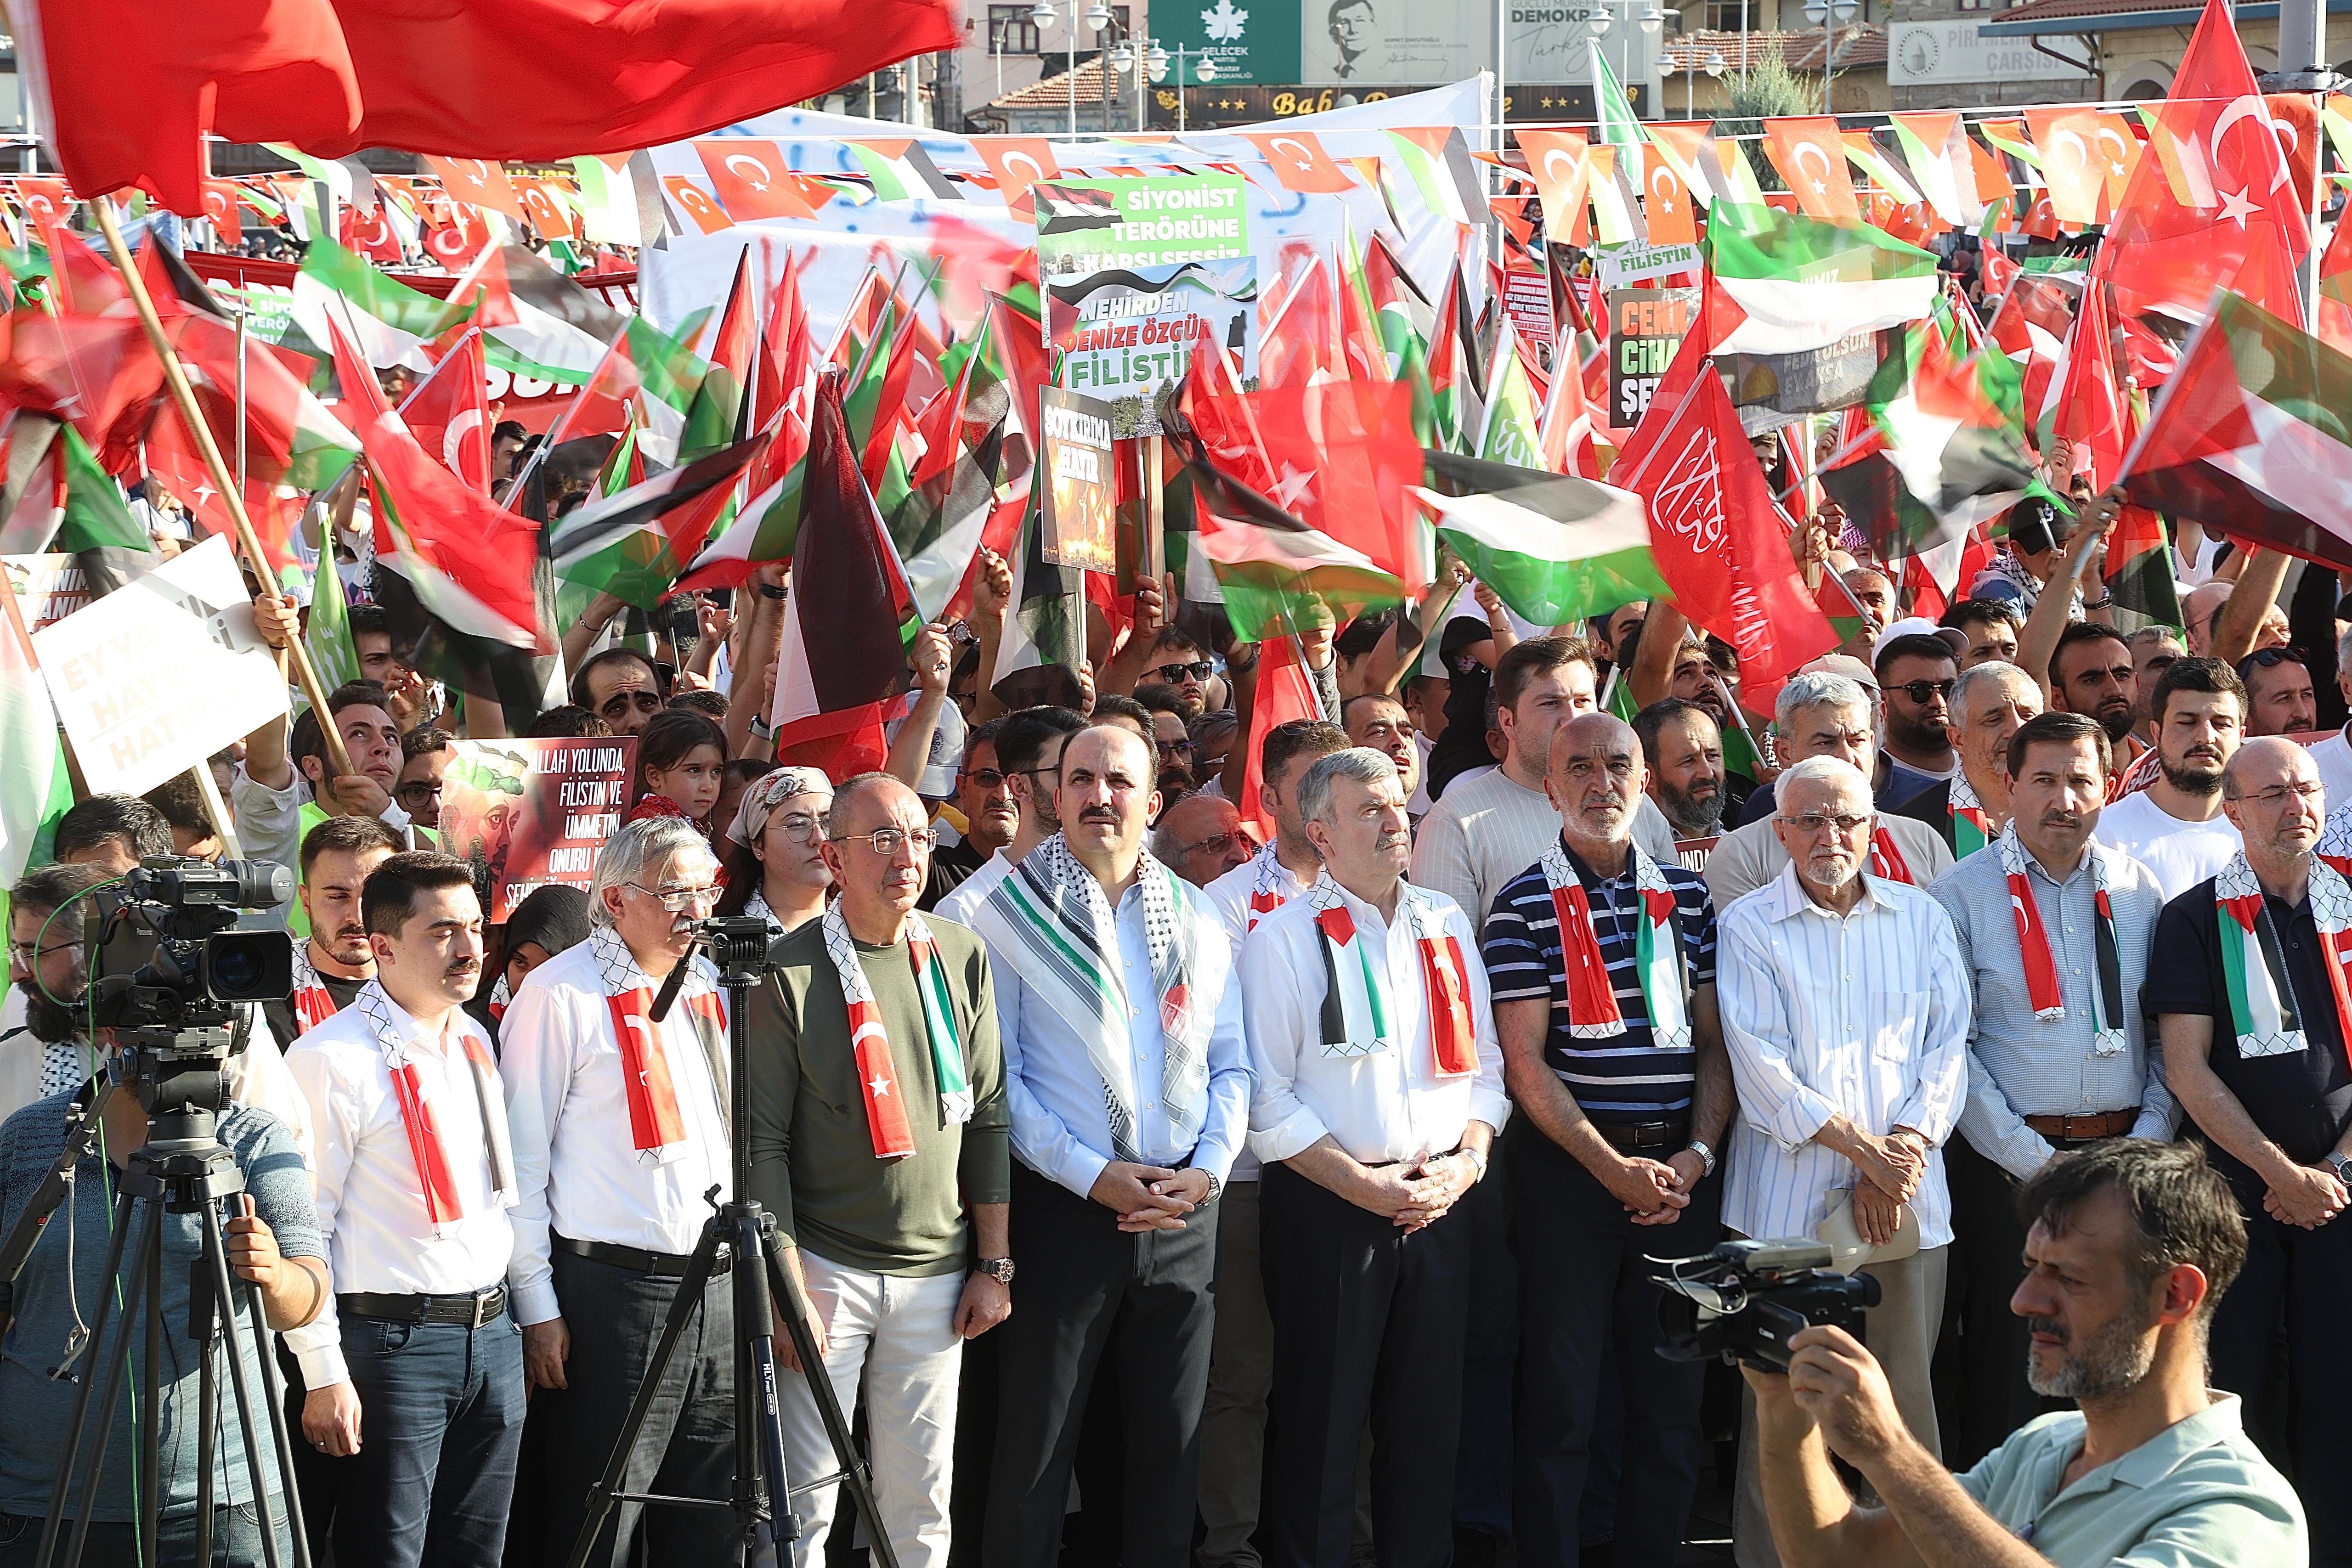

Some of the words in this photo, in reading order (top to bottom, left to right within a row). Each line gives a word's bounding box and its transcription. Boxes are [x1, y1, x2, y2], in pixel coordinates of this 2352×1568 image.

[1127, 183, 1238, 211] SİYONİST
[1110, 214, 1240, 242] TERÖRÜNE
[1620, 245, 1693, 272] FİLİSTİN
[1081, 289, 1191, 322] NEHİRDEN
[1621, 300, 1689, 336] CENK
[1063, 321, 1137, 353] DENİZE
[1142, 313, 1214, 344] ÖZGÜR
[1044, 405, 1113, 451] SOYKIRIMA
[1059, 445, 1099, 484] HAYIR
[61, 644, 106, 693] EY
[529, 749, 567, 775] ALLAH
[571, 748, 626, 777] YOLUNDA,
[559, 775, 606, 807] FİLİSTİN
[609, 780, 625, 805] VE
[564, 808, 621, 840] ÜMMETİN
[548, 848, 589, 874] ONURU
[763, 1363, 772, 1381] HLY
